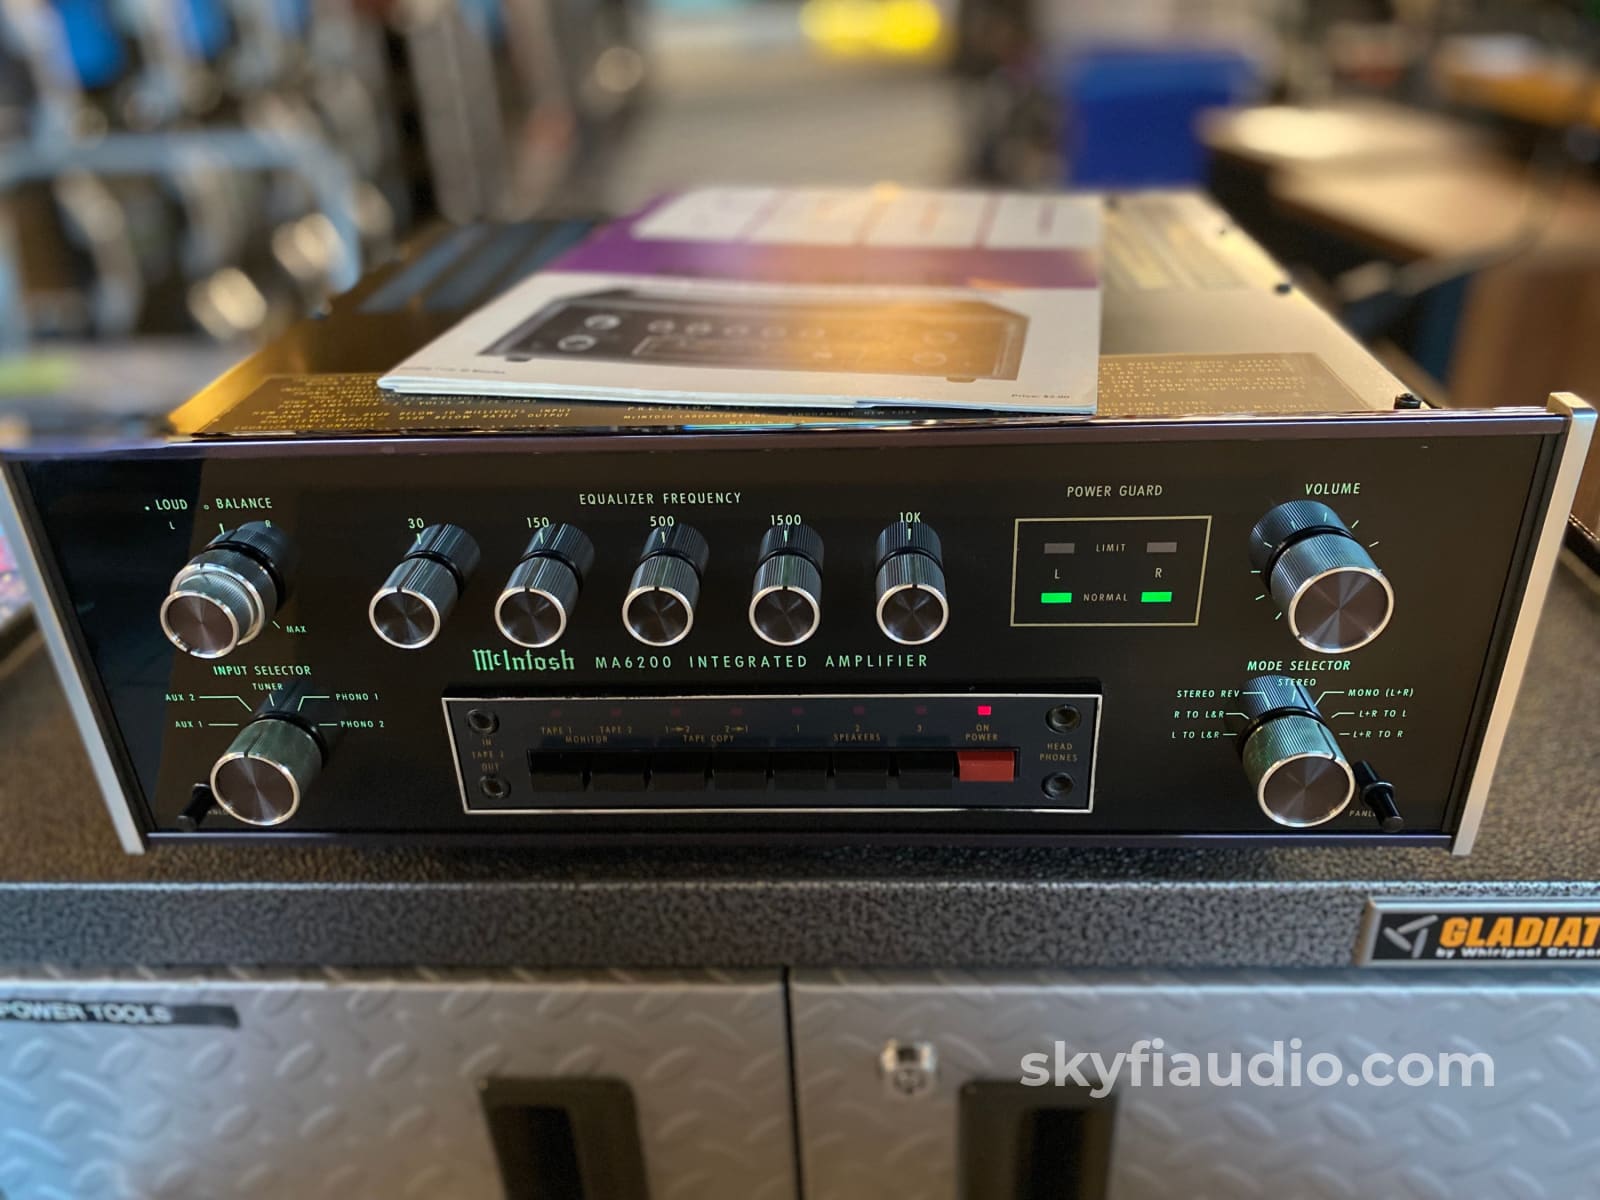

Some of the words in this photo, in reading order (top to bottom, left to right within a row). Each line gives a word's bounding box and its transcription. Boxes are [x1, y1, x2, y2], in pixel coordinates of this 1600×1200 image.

[1066, 485, 1112, 498] POWER
[1119, 484, 1163, 497] GUARD
[1304, 482, 1361, 496] VOLUME
[215, 497, 273, 510] BALANCE
[578, 493, 654, 505] EQUALIZER
[662, 491, 742, 505] FREQUENCY
[154, 498, 189, 511] LOUD
[407, 517, 425, 529] 30
[526, 516, 550, 529] 150
[649, 515, 675, 528] 500
[770, 513, 802, 527] 1500
[899, 511, 921, 524] 10K
[168, 520, 176, 531] L
[264, 518, 272, 529] R
[1095, 543, 1127, 553] LIMIT
[1053, 568, 1061, 580] L
[1154, 567, 1163, 579] R
[1083, 592, 1128, 603] NORMAL
[286, 624, 307, 634] MAX
[472, 648, 576, 672] McIntosh
[594, 655, 672, 670] MA6200
[688, 655, 808, 669] INTEGRATED
[825, 653, 928, 668] AMPLIFIER
[1246, 660, 1284, 672] MODE
[1289, 659, 1352, 671] SELECTOR
[212, 664, 248, 677] INPUT
[253, 664, 312, 676] SELECTOR
[251, 682, 284, 692] TUNER
[1277, 677, 1317, 687] STEREO
[164, 692, 186, 702] AUX
[188, 692, 196, 702] 2
[335, 692, 370, 702] PHONO
[373, 692, 379, 701] 1
[1176, 689, 1216, 699] STEREO
[1220, 688, 1241, 698] REV
[1347, 687, 1381, 697] MONO
[1385, 686, 1414, 698] (L+R)
[1173, 710, 1181, 719] R
[1186, 710, 1200, 719] TO
[1204, 710, 1225, 719] L&R
[1358, 709, 1378, 719] L+R
[1383, 709, 1397, 718] TO
[1401, 709, 1408, 718] L
[174, 720, 194, 729] AUX
[197, 719, 204, 728] 1
[340, 719, 375, 729] PHONO
[378, 719, 385, 728] 2
[975, 723, 990, 733] ON
[711, 734, 735, 744] COPY
[832, 733, 882, 743] SPEAKERS
[964, 733, 998, 743] POWER
[1171, 730, 1177, 739] L
[1182, 730, 1196, 739] TO
[1200, 730, 1221, 739] L&R
[1352, 729, 1372, 739] L+R
[1377, 729, 1392, 738] TO
[1396, 729, 1404, 738] R
[565, 735, 609, 745] MONITOR
[1046, 742, 1073, 752] HEAD
[1039, 753, 1078, 763] PHONES
[1438, 916, 1600, 948] GLADIAT
[1435, 946, 1457, 960] by
[1460, 946, 1542, 960] Whirlpool
[88, 1003, 173, 1023] TOOLS
